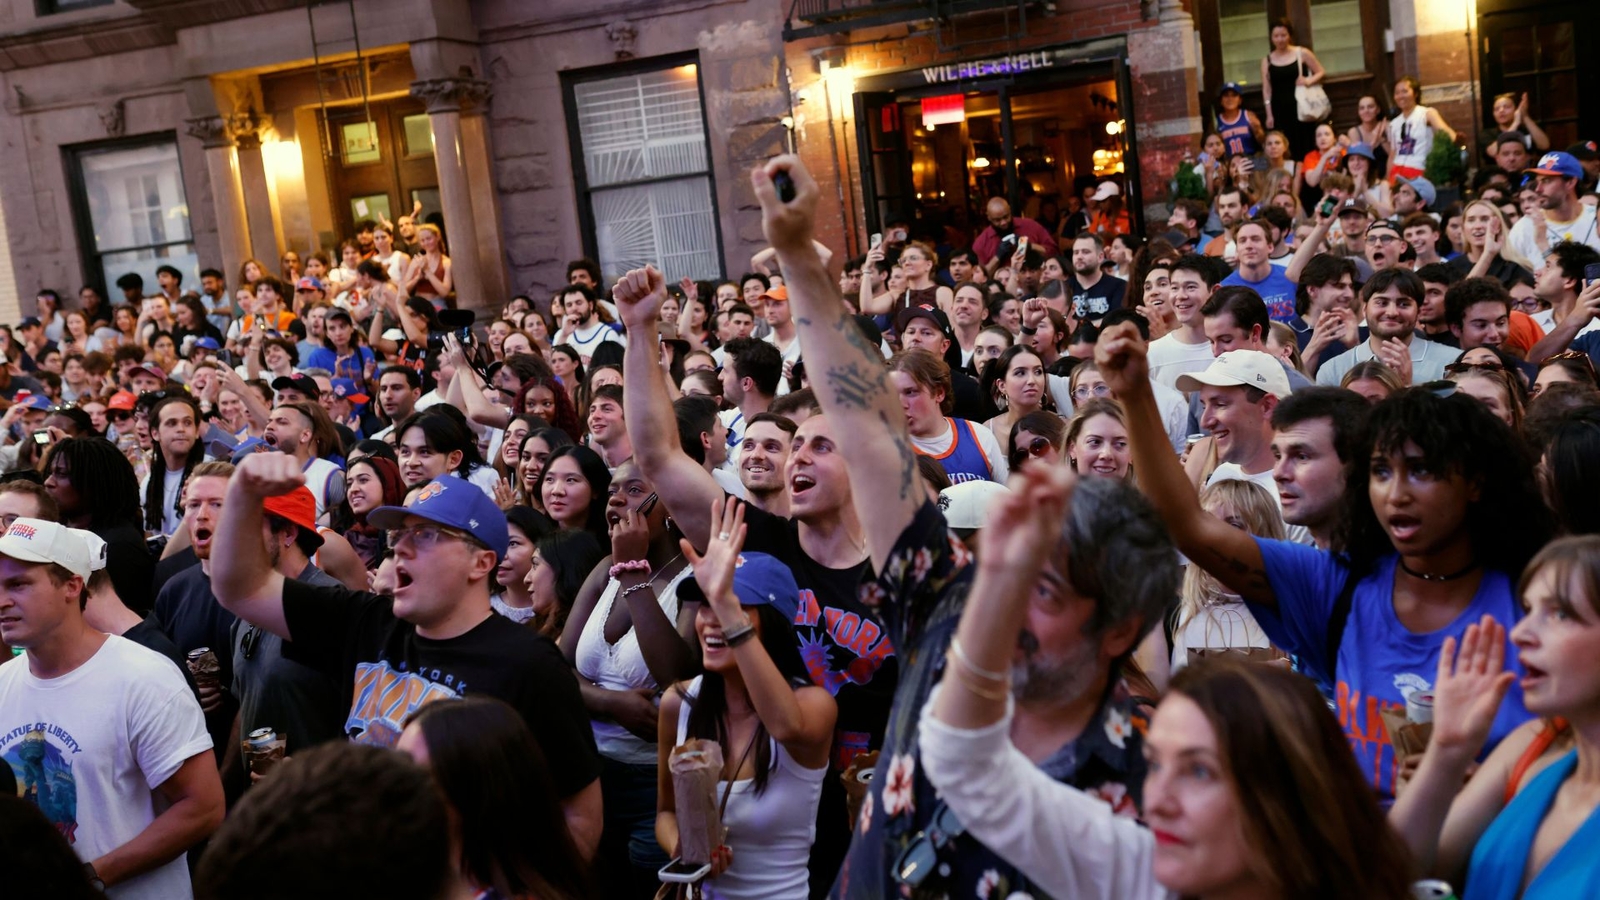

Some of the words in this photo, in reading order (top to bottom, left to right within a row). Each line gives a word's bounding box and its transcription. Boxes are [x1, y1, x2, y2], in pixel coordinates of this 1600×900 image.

[922, 60, 986, 84] WILFIE
[989, 61, 1002, 74] &
[1004, 51, 1054, 73] NELL
[822, 605, 896, 668] YORK
[418, 666, 467, 695] YORK
[34, 722, 47, 733] OF
[47, 723, 83, 755] LIBERTY
